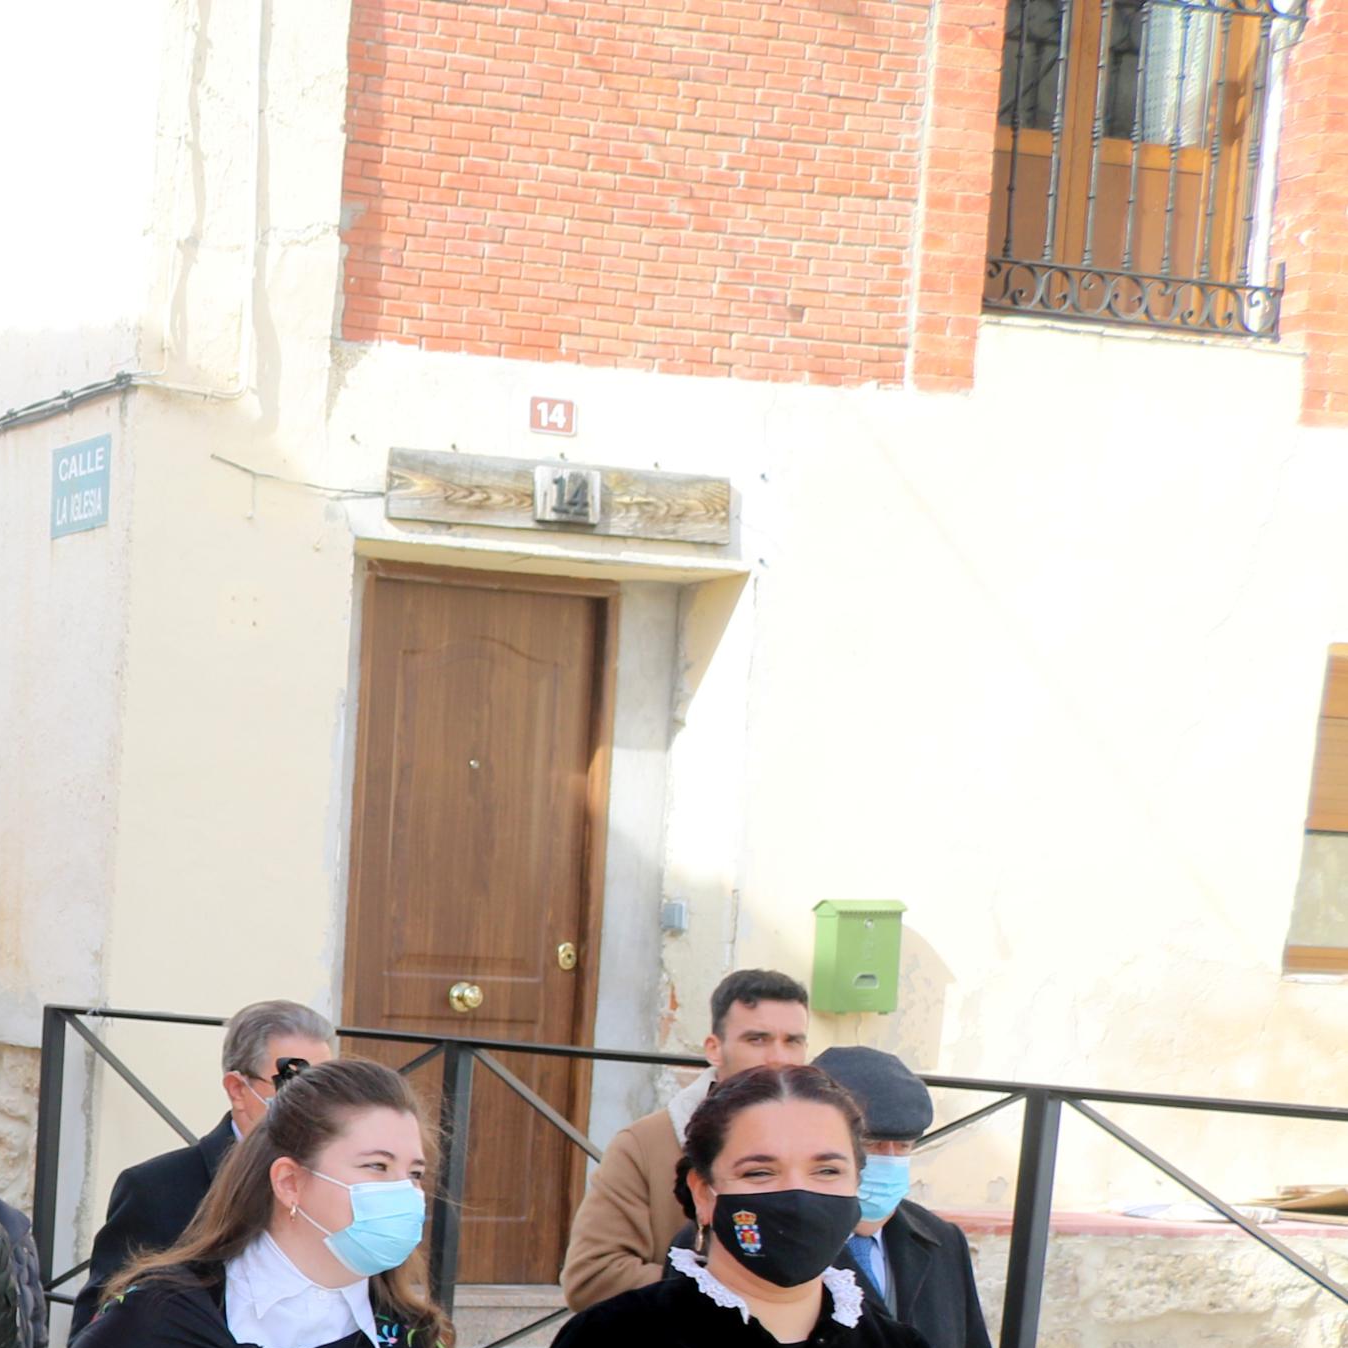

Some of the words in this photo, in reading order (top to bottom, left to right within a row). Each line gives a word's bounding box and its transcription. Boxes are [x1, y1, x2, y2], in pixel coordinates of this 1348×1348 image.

[537, 402, 566, 429] 14
[58, 447, 105, 481] CALLE
[56, 495, 68, 526] LA
[70, 488, 103, 522] IGLESIA
[552, 473, 589, 517] 14
